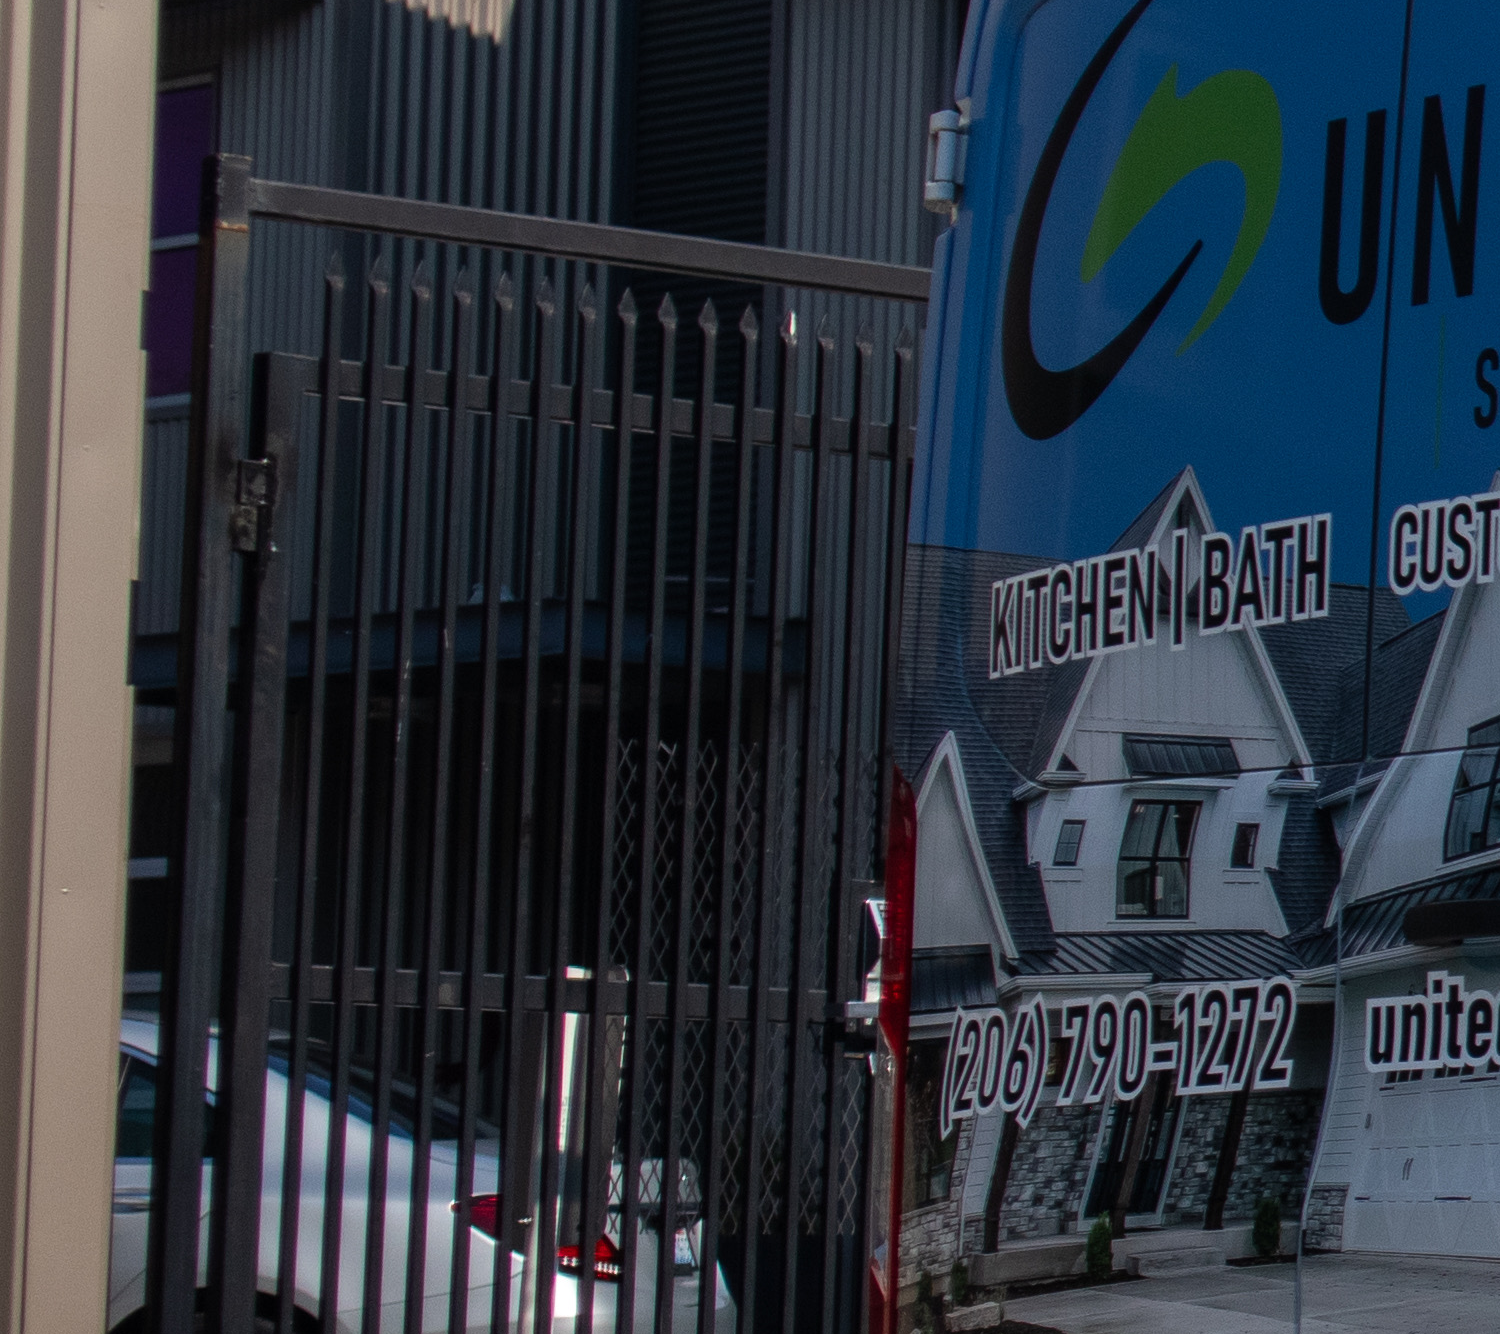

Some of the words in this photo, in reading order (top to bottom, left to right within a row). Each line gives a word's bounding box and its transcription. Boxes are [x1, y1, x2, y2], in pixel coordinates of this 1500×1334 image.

[991, 544, 1159, 679] KITCHEN
[1200, 512, 1333, 633] BATH
[939, 995, 1047, 1138] (206)
[1056, 975, 1298, 1107] 790-1272
